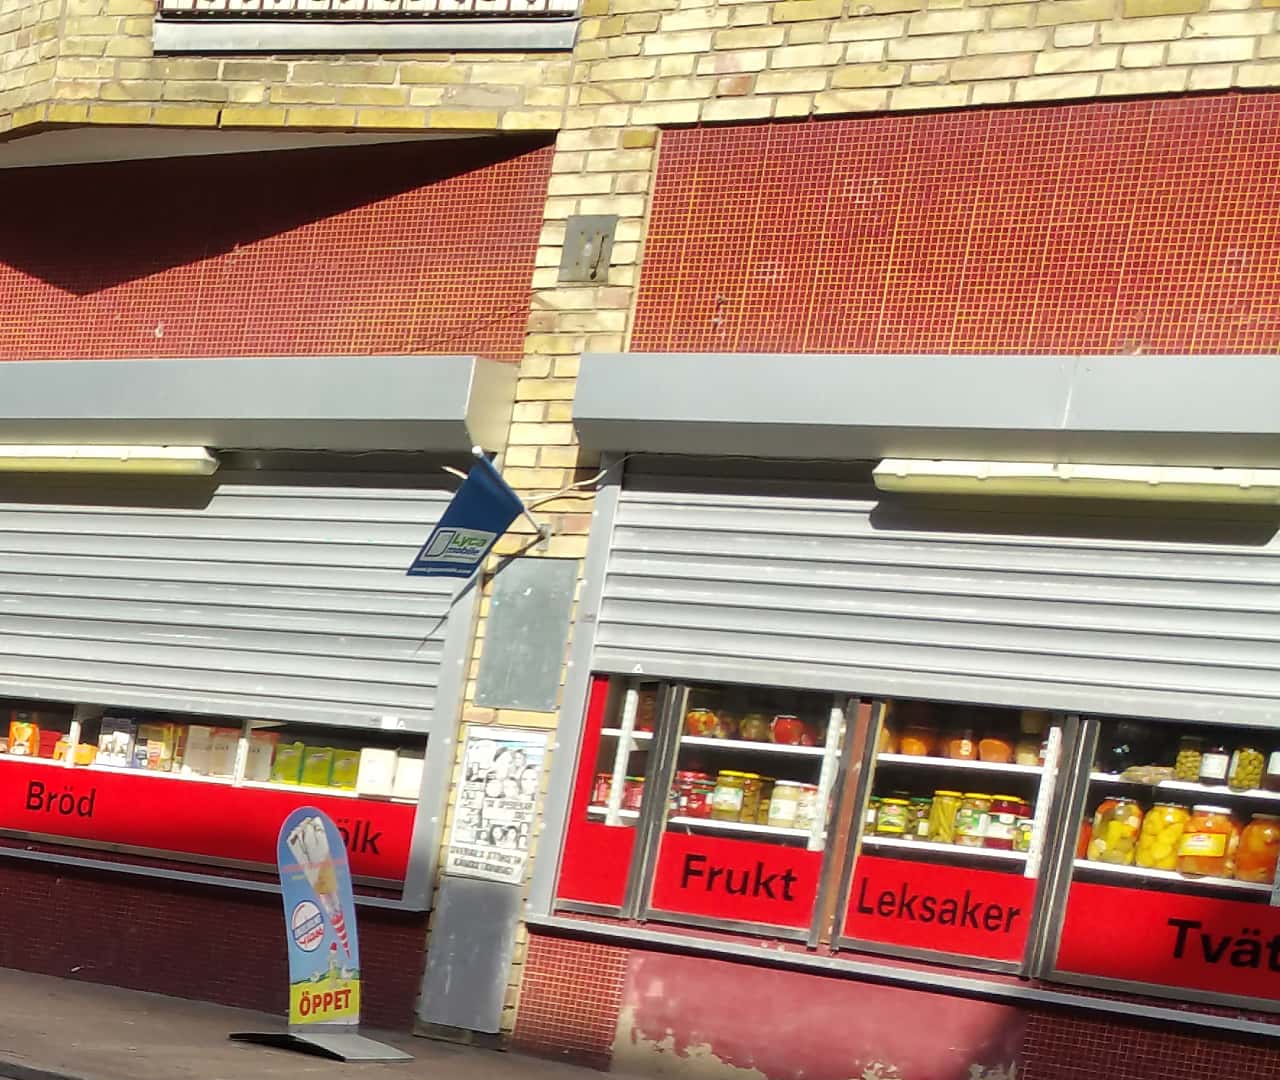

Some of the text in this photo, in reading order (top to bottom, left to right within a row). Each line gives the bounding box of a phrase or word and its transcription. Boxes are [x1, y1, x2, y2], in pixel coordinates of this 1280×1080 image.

[25, 780, 97, 817] Bröd
[338, 819, 382, 855] ölk
[680, 853, 798, 902] Frukt
[856, 876, 1021, 934] Leksaker
[299, 988, 352, 1016] ÖPPET
